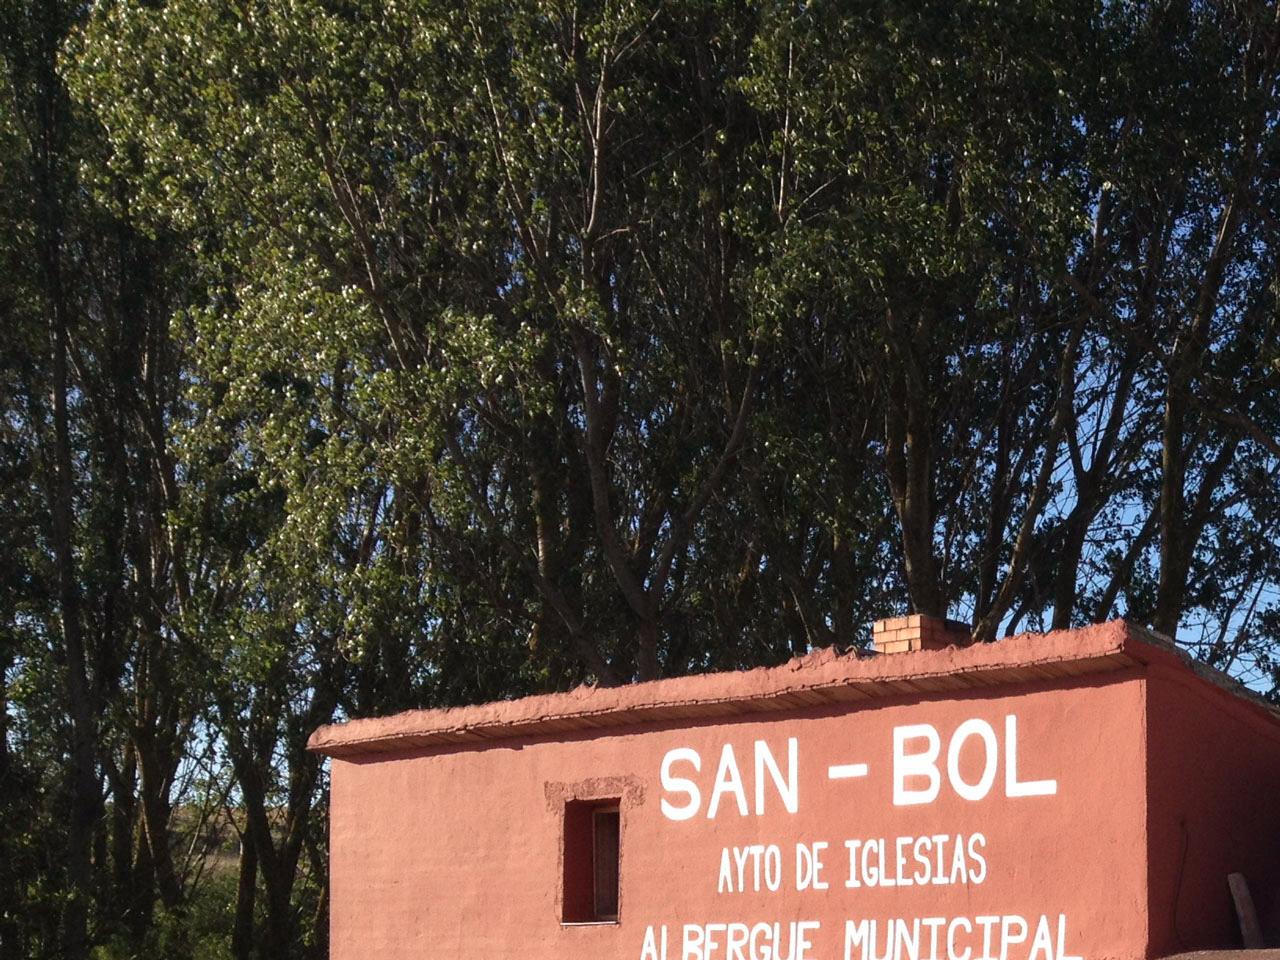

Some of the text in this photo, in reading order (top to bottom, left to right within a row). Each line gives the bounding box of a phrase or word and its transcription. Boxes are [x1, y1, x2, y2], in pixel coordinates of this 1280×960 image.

[659, 714, 1057, 821] SAN - BOL
[717, 832, 988, 895] AYTO DE IGLESIAS
